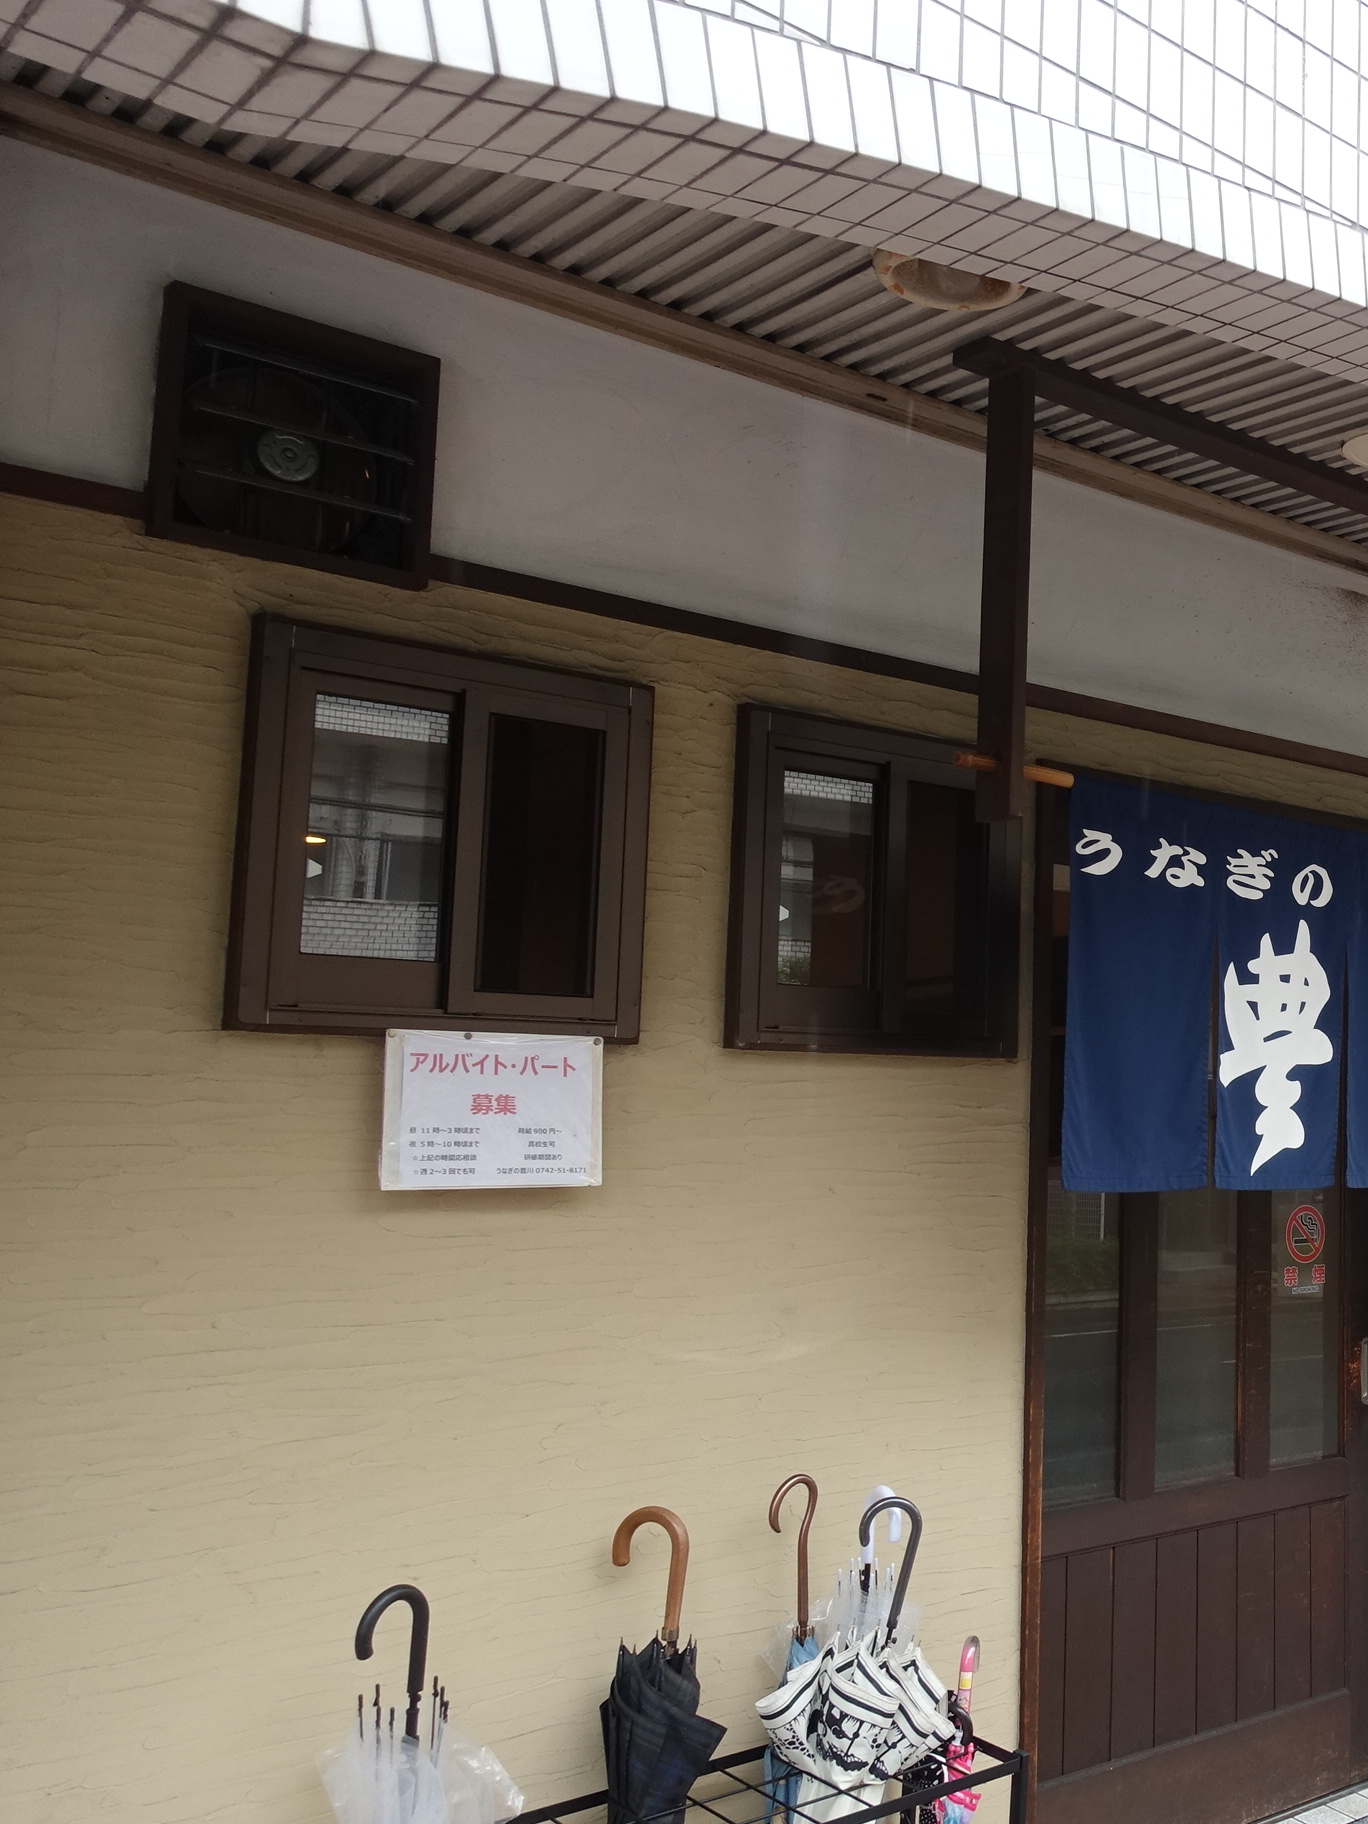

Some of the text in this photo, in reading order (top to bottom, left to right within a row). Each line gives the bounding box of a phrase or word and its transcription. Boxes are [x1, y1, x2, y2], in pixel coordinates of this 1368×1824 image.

[1075, 829, 1334, 908] うなぎの
[409, 1052, 576, 1077] アルバイト・パート
[470, 1093, 517, 1116] 募集
[1284, 1264, 1325, 1286] 禁煙
